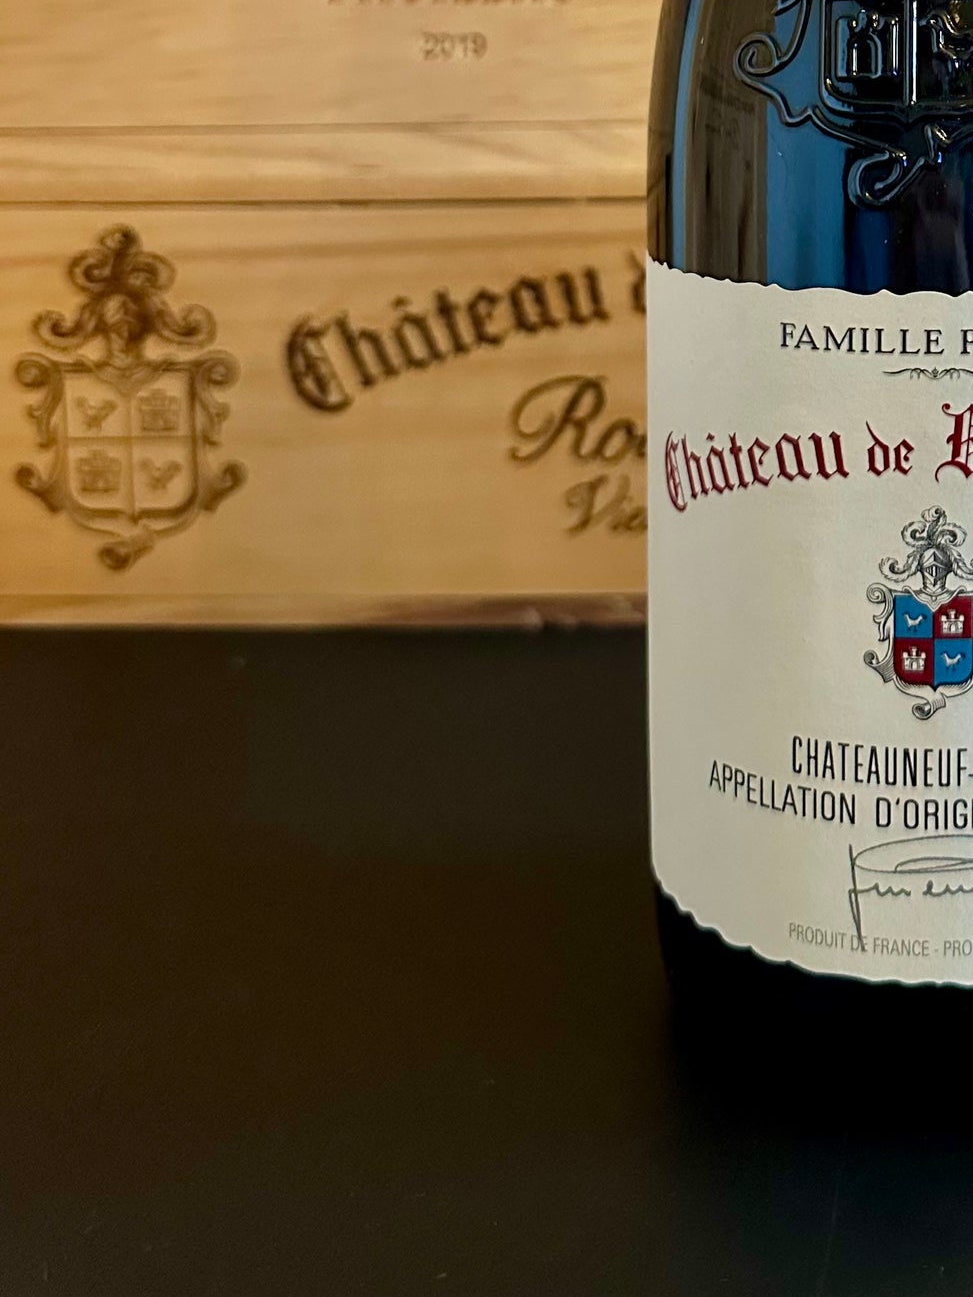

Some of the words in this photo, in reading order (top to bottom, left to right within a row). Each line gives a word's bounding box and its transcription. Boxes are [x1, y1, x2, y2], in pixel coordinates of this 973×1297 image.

[287, 265, 610, 412] Château
[780, 322, 945, 355] FAMILLE
[665, 430, 849, 512] Château
[865, 420, 915, 476] de
[708, 759, 856, 826] APPELLATION
[788, 921, 847, 949] PRODUIT
[872, 936, 929, 957] FRANCE
